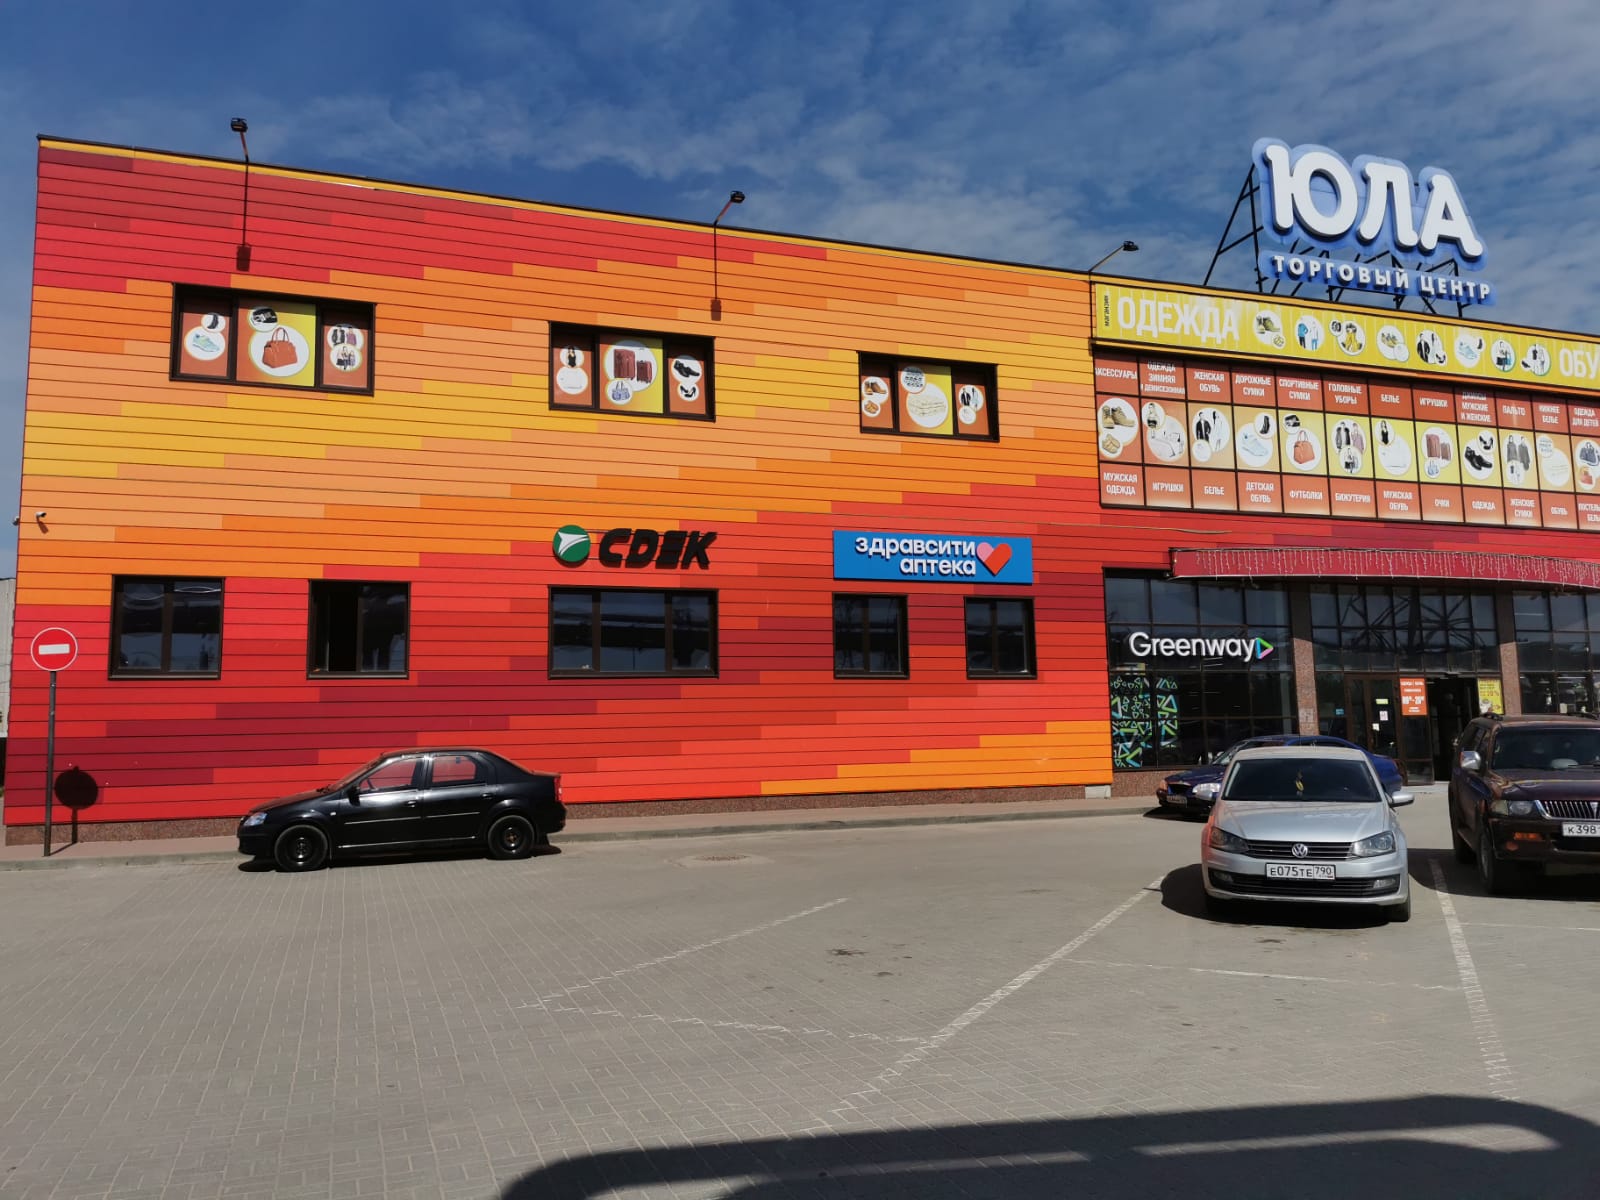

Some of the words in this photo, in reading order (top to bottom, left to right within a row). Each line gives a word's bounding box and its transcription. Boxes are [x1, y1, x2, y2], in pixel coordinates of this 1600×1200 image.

[1264, 144, 1483, 258] ЮЛА
[1272, 254, 1409, 290] ТОРГОВЫЙ
[1419, 274, 1491, 301] ЦЕНТР
[1117, 297, 1240, 344] ОДЕЖДА
[1194, 371, 1225, 382] ЖЕНСКАЯ
[1235, 374, 1272, 386] ДОРОЖНЫЕ
[1199, 383, 1221, 393] ОБУВЬ
[1279, 378, 1319, 390] СПОРТИВНЫЕ
[1328, 383, 1362, 395] ГОЛОВНЫЕ
[1242, 386, 1265, 397] СУМКИ
[1288, 391, 1311, 401] СУМКИ
[1335, 394, 1358, 405] УБОРЫ
[1380, 394, 1400, 404] БЕЛЬЕ
[1419, 397, 1448, 408] ИГРУШКИ
[1502, 405, 1526, 416] ПАЛЬТО
[1103, 472, 1138, 483] МУЖСКАЯ
[1106, 485, 1136, 496] ОДЕЖДА
[1152, 482, 1184, 493] ИГРУШКИ
[1204, 486, 1225, 496] БЕЛЬЕ
[1245, 482, 1275, 492] ДЕТСКАЯ
[1250, 493, 1271, 504] ОБУВЬ
[1289, 489, 1323, 501] ФУТБОЛКИ
[1335, 492, 1371, 504] БИЖУТЕРИЯ
[1383, 490, 1413, 500] МУЖСКАЯ
[1389, 502, 1409, 511] ОБУВЬ
[599, 528, 718, 570] CDEK
[855, 536, 976, 560] здравсити
[899, 558, 976, 577] аптека
[1128, 631, 1258, 663] Greenway
